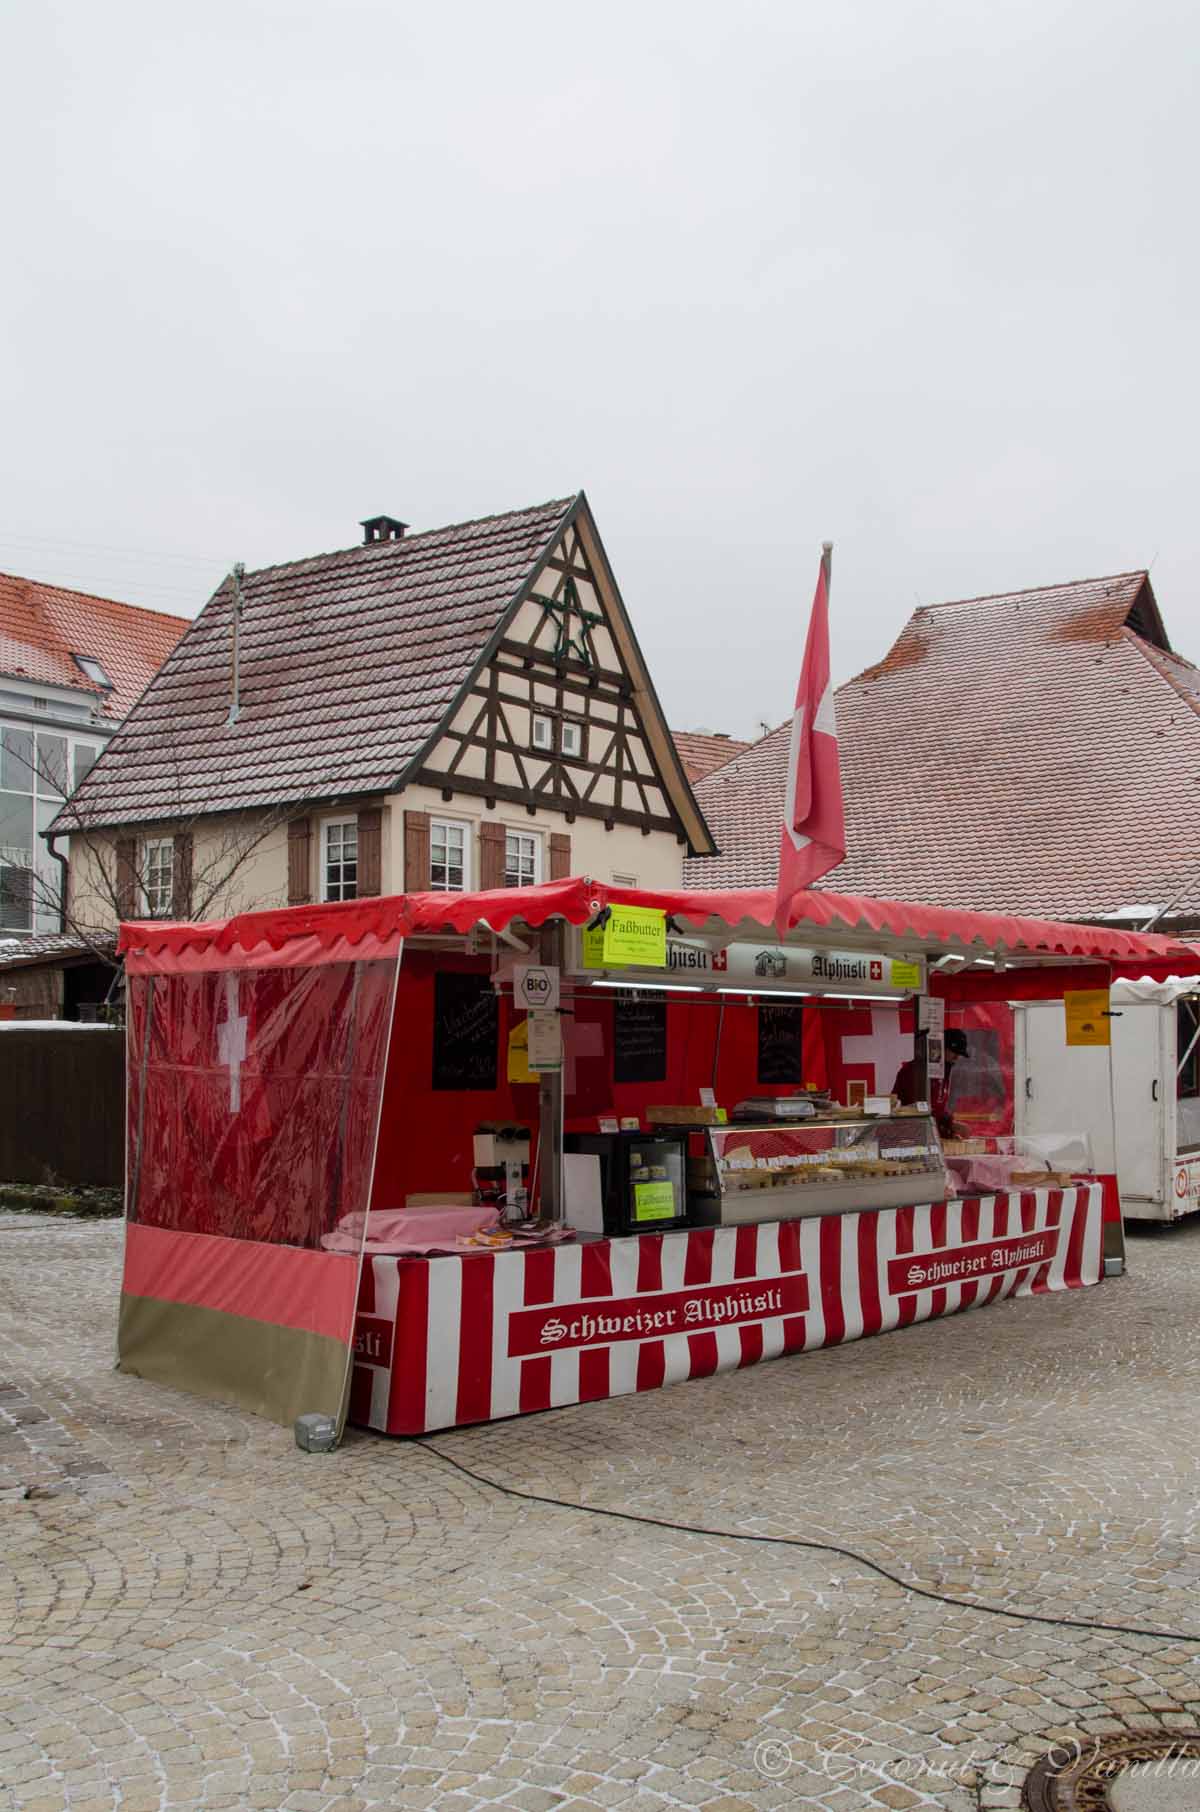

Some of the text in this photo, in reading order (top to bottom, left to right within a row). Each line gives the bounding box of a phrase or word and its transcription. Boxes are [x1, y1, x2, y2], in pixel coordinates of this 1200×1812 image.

[611, 919, 662, 937] Faßbutter
[665, 943, 707, 969] hüsli
[811, 956, 867, 981] Alphüsli
[906, 1240, 1045, 1285] Schweizer Alphüsli
[539, 1288, 783, 1345] Schweizer Alphüsli
